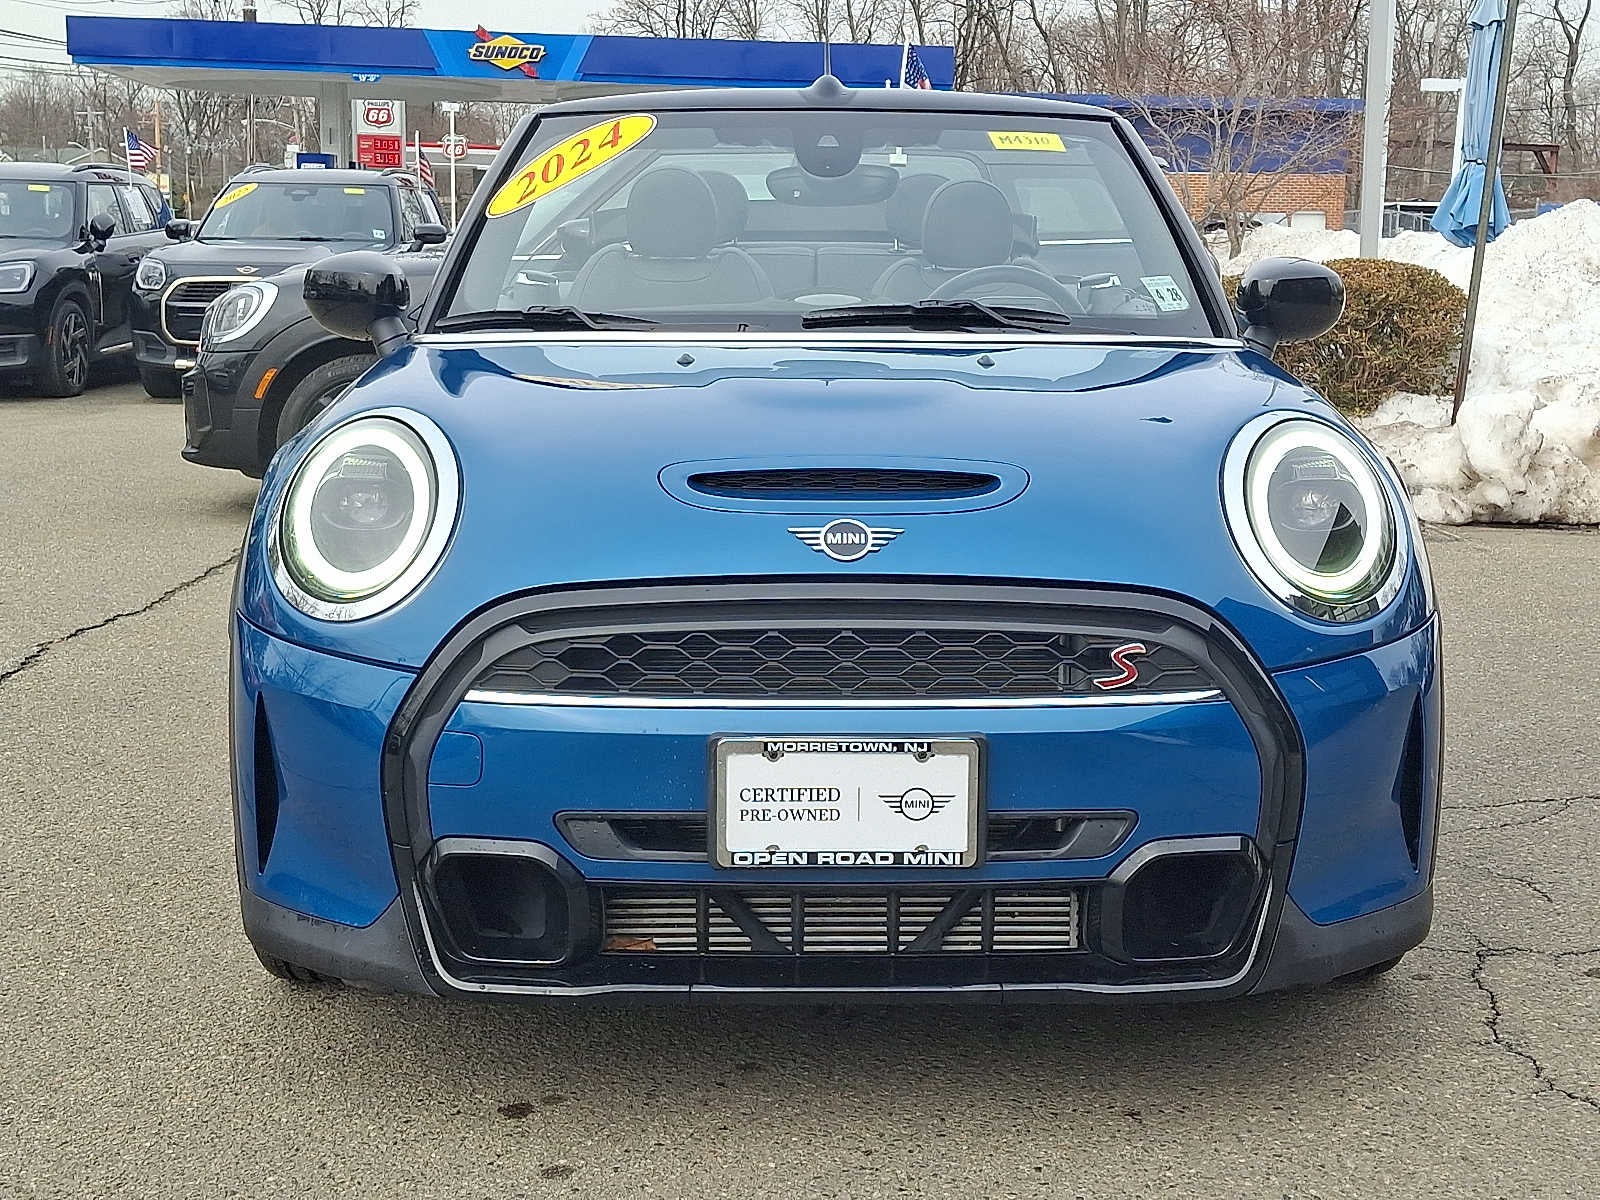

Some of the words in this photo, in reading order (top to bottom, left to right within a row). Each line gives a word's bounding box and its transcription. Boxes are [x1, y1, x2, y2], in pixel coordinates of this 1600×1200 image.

[472, 45, 542, 60] SUNOCO
[368, 109, 389, 122] 66
[516, 121, 622, 204] 2024
[1166, 287, 1183, 302] 28
[826, 532, 866, 545] MINI
[1093, 643, 1147, 690] S
[766, 742, 898, 753] MORRISTOWN,
[904, 743, 929, 752] NJ
[739, 788, 841, 802] CERTIFIED
[904, 799, 930, 809] MINI
[739, 809, 841, 822] PRE-OWNED
[733, 852, 808, 865] OPEN
[817, 852, 894, 865] ROAD
[903, 852, 961, 865] MINI
